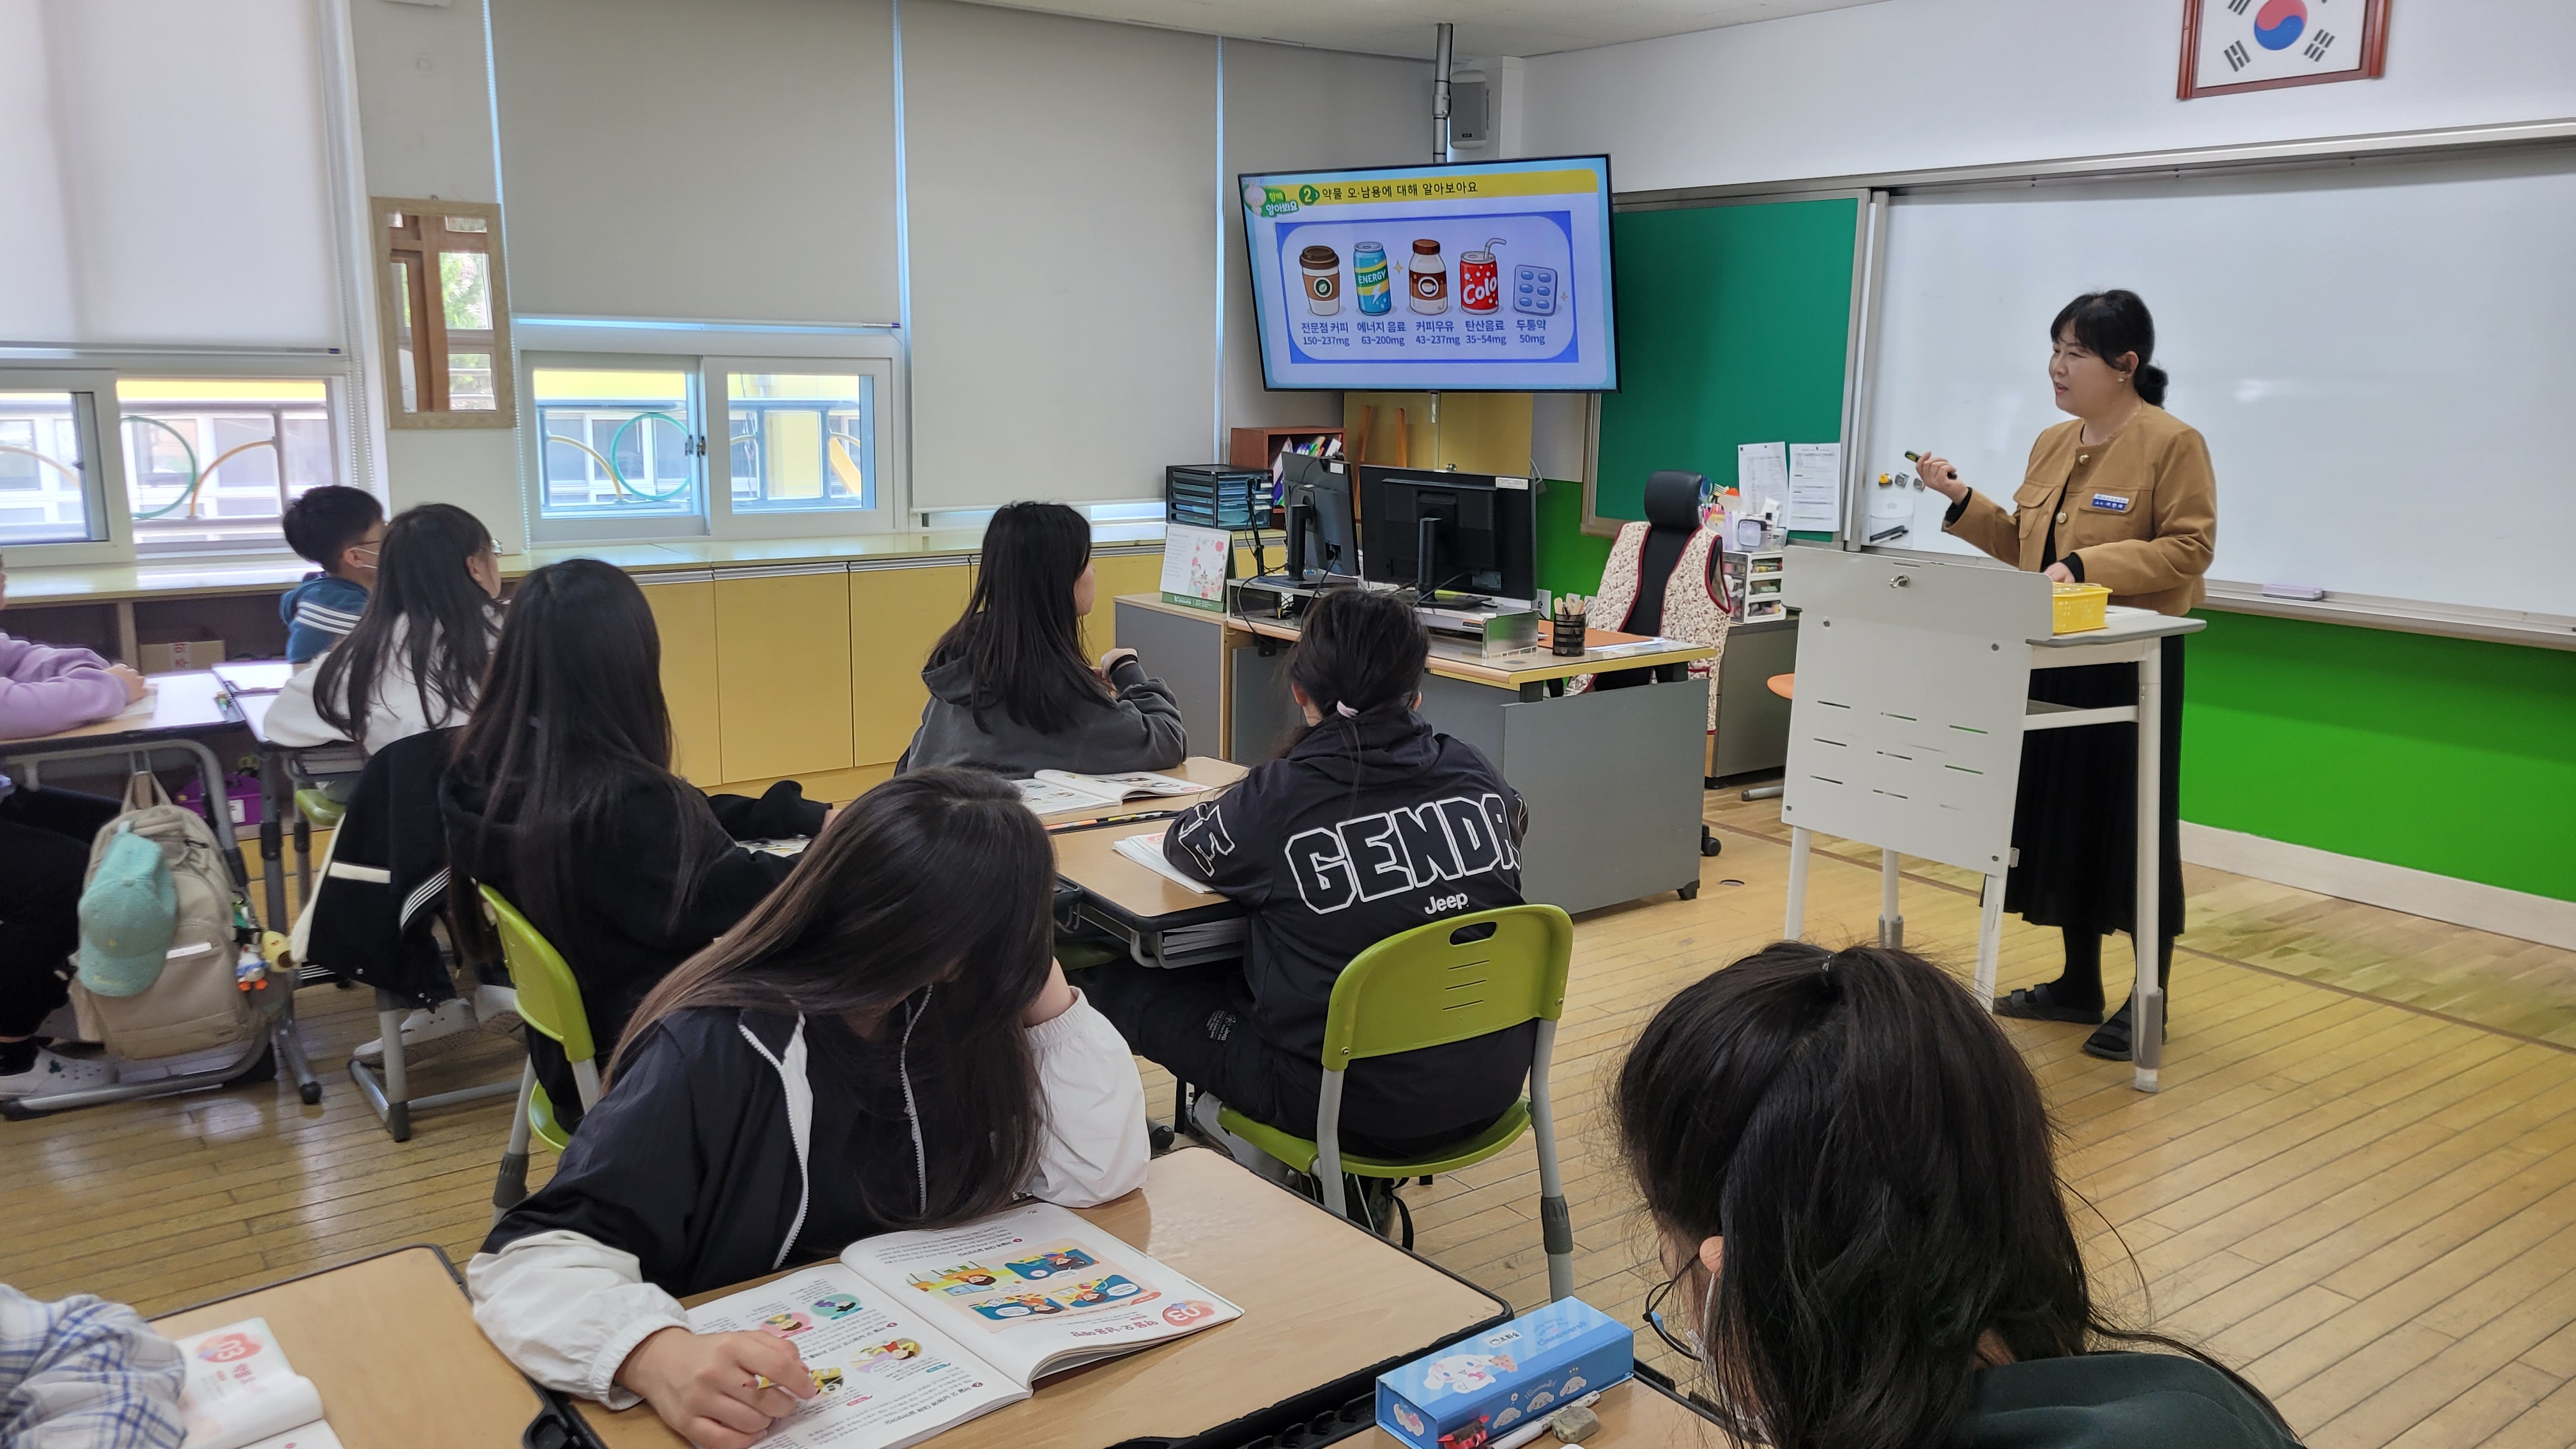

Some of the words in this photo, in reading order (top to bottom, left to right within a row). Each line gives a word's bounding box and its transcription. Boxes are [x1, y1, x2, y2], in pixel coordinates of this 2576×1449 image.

[1304, 188, 1312, 203] 2
[1322, 188, 1342, 201] 약물
[1347, 184, 1392, 199] 오·남용에
[1397, 183, 1418, 197] 대해
[1422, 181, 1478, 196] 알아보아요
[1266, 201, 1298, 216] 알아봐요
[1358, 269, 1386, 284] ENERGY
[1301, 322, 1328, 334] 전문점
[1330, 321, 1349, 334] 커피
[1357, 321, 1385, 333] 에너지
[1387, 321, 1406, 333] 음료
[1416, 321, 1454, 332] 커피우유
[1466, 319, 1505, 332] 탄산음료
[1516, 318, 1547, 331] 두통약
[1303, 336, 1350, 347] 150~237mg
[1361, 336, 1405, 347] 63~200mg
[1416, 335, 1460, 346] 43~237mg
[1466, 334, 1506, 346] 35~54mg
[1519, 334, 1545, 345] 50mg
[1425, 892, 1468, 915] Jeep
[1167, 1307, 1201, 1321] 03
